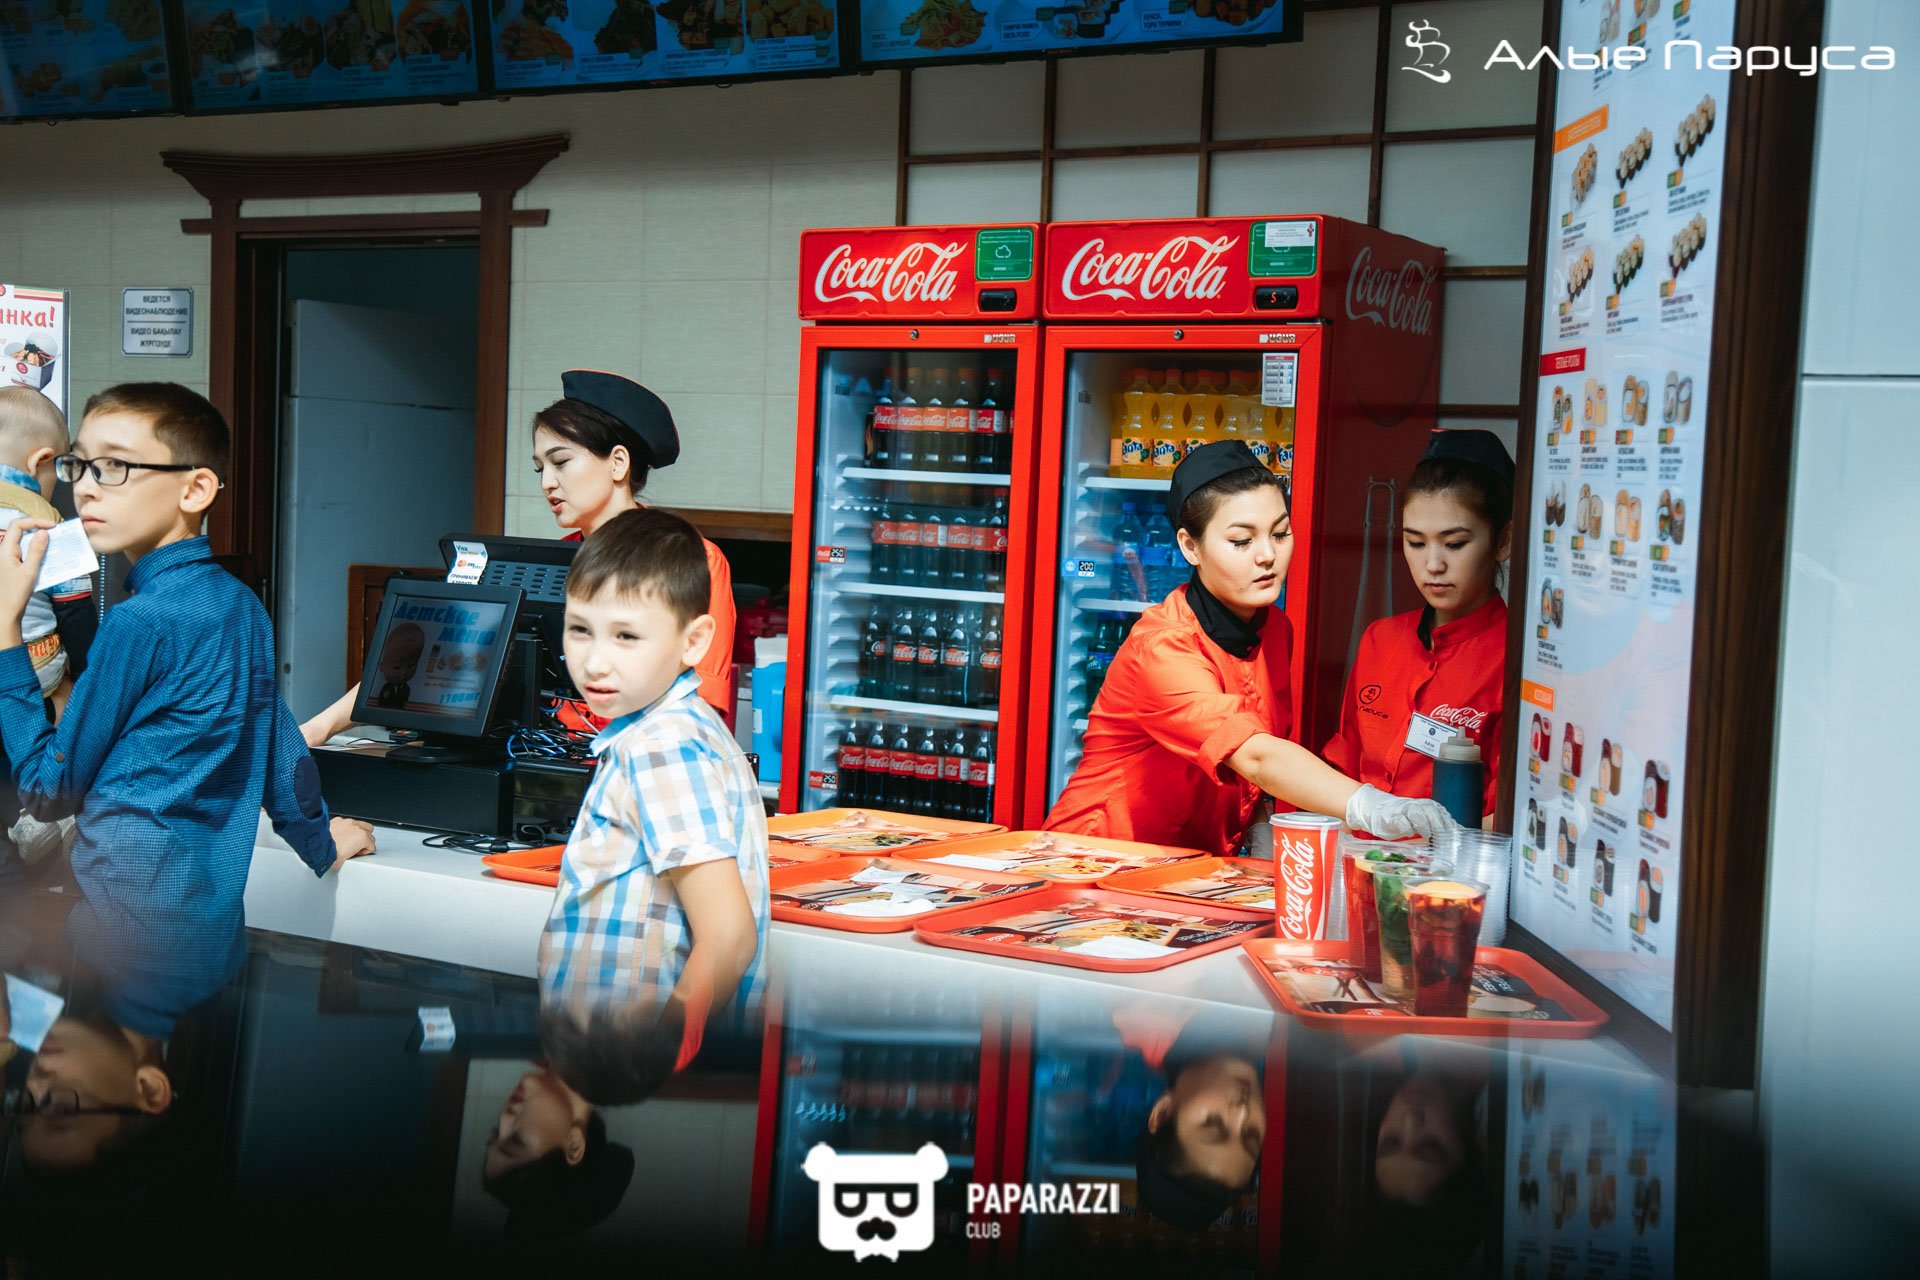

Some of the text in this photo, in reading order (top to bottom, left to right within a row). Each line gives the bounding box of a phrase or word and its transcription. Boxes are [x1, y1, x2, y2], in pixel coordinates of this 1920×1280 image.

[814, 241, 969, 303] Coca-Cola
[1062, 235, 1241, 300] Coca-Cola
[142, 295, 171, 303] ВЕДЕТСЯ
[1345, 245, 1439, 336] Coca-Cola
[0, 305, 55, 329] нка!
[125, 307, 188, 316] ВИДЕОНАБЛЮДЕНИЕ
[130, 327, 152, 336] ВИДЕО
[1122, 441, 1143, 455] anta
[1154, 443, 1176, 457] anta
[1430, 704, 1489, 731] Coca-Cola
[1279, 832, 1315, 940] Coca-Cola
